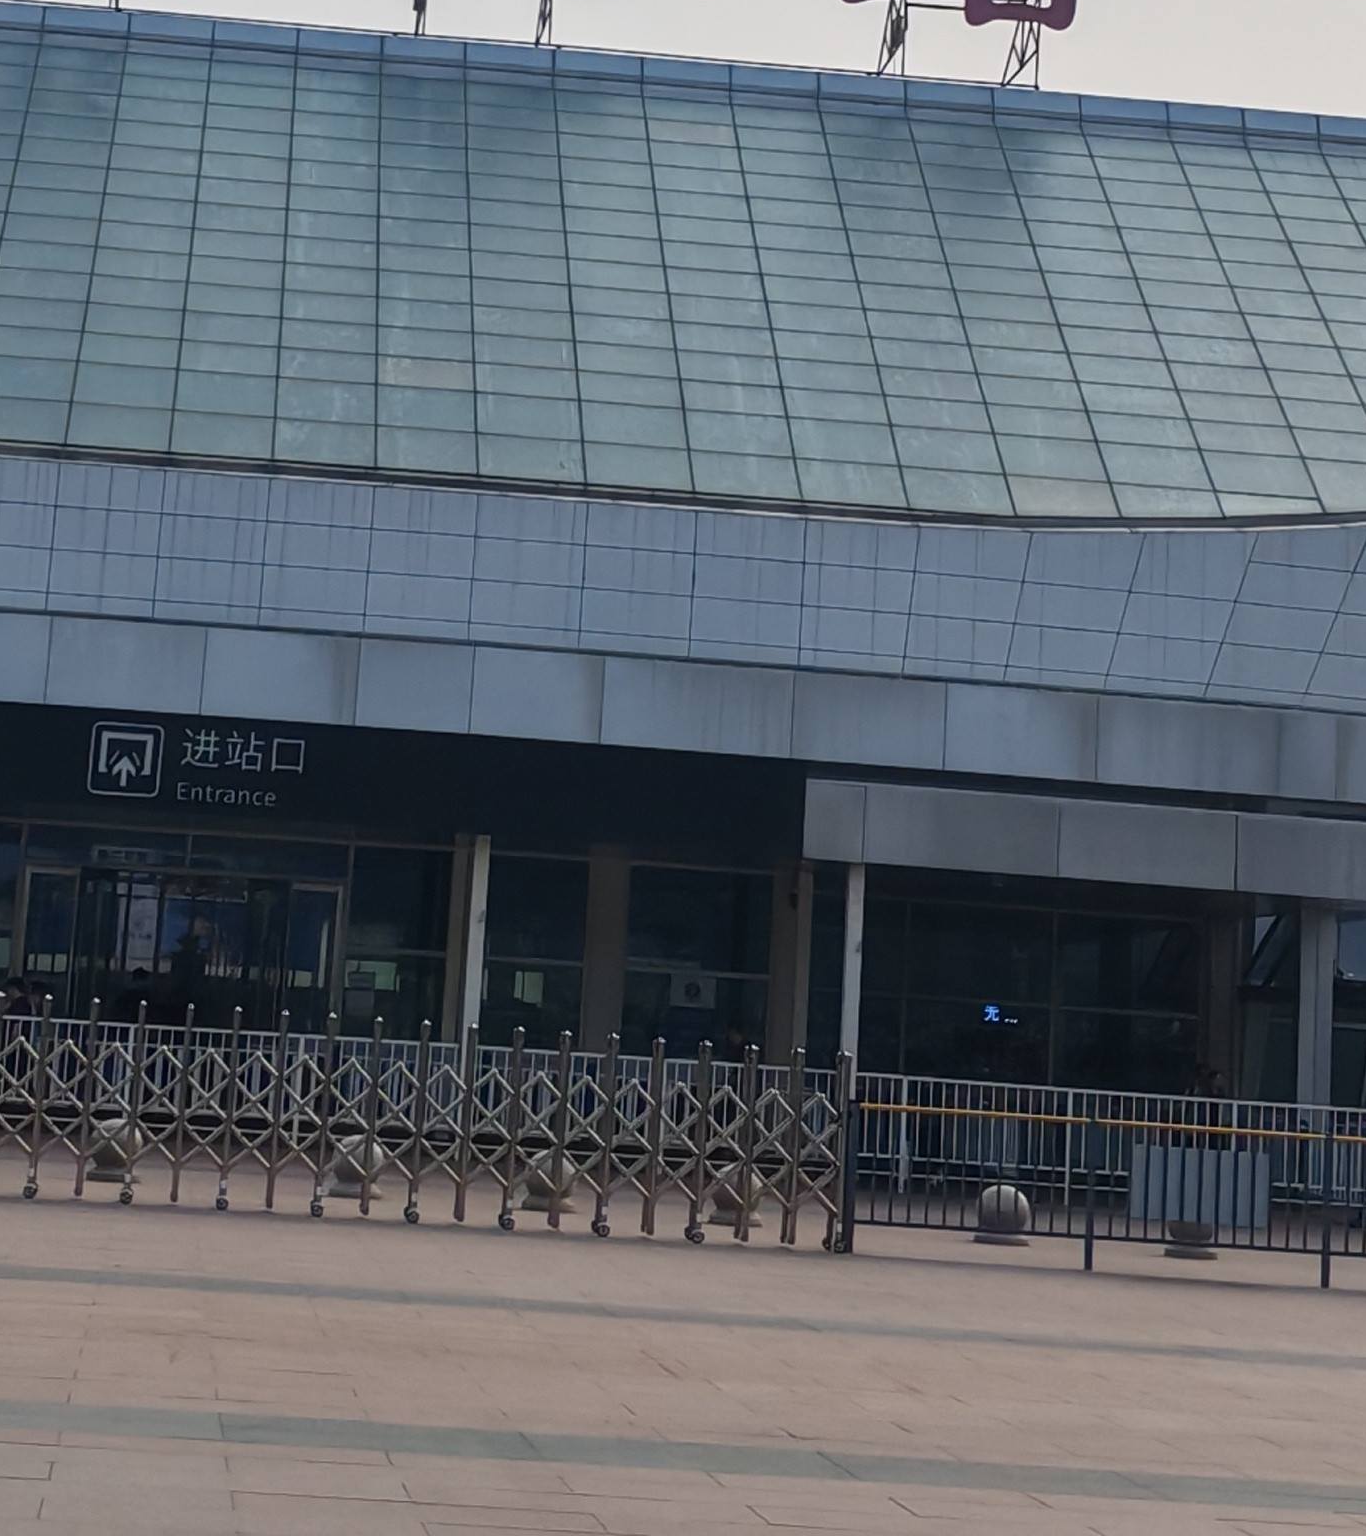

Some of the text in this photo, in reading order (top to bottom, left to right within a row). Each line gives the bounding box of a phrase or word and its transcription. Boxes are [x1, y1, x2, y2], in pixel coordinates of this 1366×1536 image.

[181, 728, 305, 774] 进站口
[176, 781, 277, 807] Entrance
